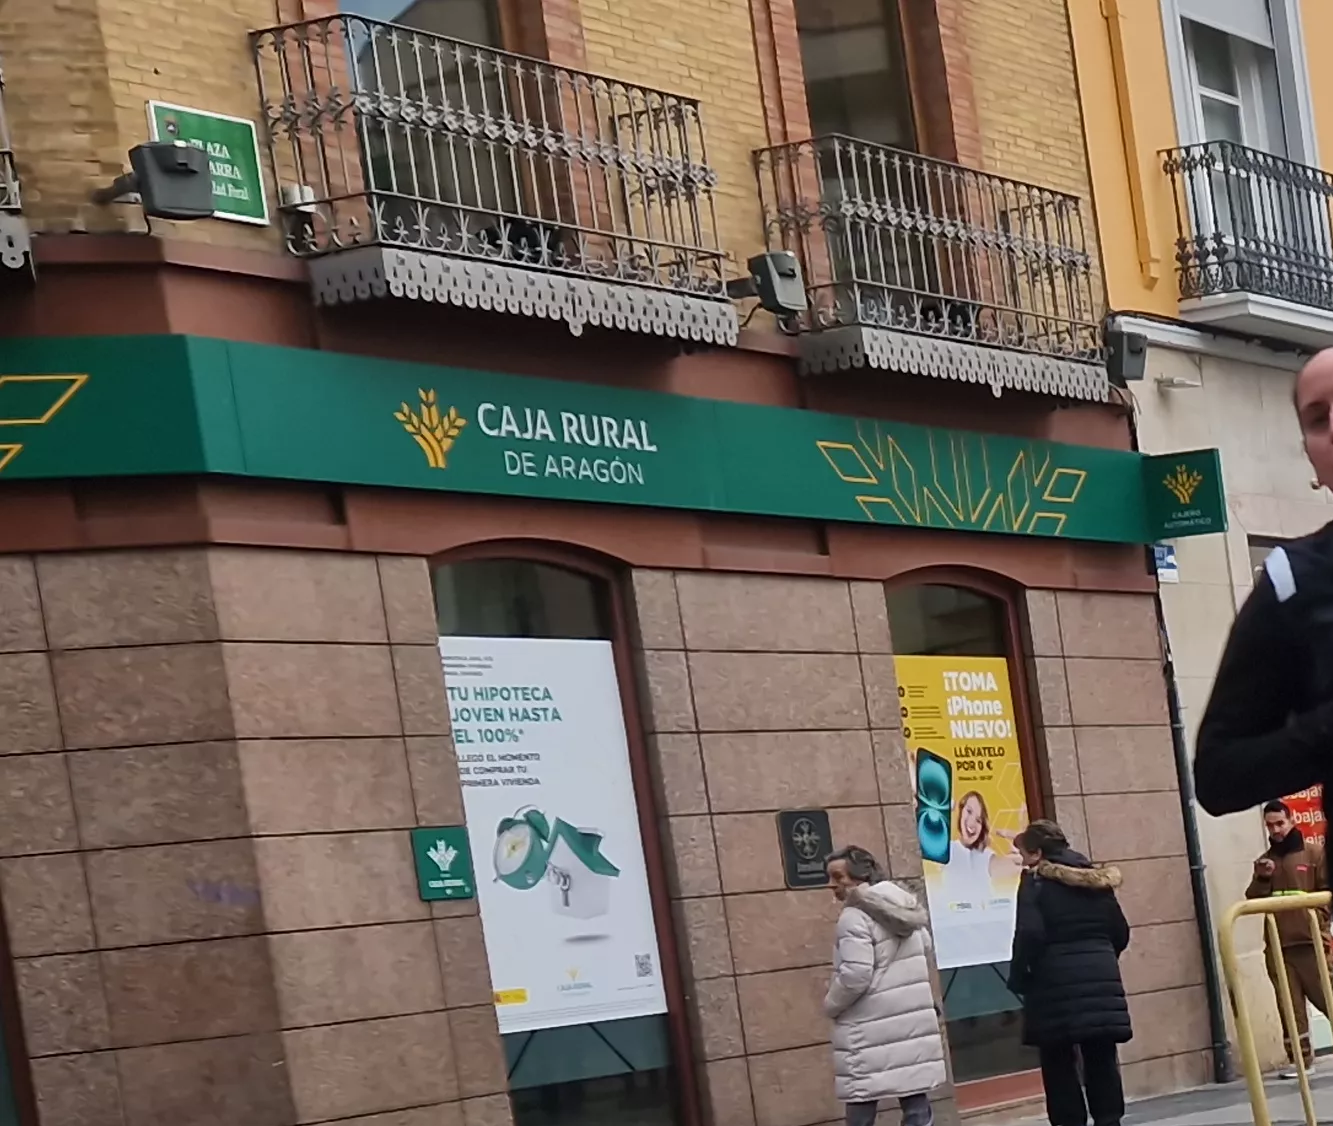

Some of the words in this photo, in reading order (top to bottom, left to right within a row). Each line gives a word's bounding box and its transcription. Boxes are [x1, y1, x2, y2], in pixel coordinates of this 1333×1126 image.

[477, 403, 557, 442] CAJA
[560, 411, 658, 452] RURAL
[504, 450, 539, 477] DE
[544, 455, 645, 485] ARAGÓN
[446, 686, 468, 701] TU
[472, 686, 554, 701] HIPOTECA
[452, 707, 505, 722] JOVEN
[508, 707, 562, 722] HASTA
[453, 728, 474, 744] EL
[950, 719, 1013, 739] NUEVO!
[498, 752, 541, 762] MOMENTO
[472, 765, 514, 775] COMPRAR
[516, 765, 527, 774] TU
[956, 760, 976, 772] POR
[979, 760, 985, 771] 0
[985, 760, 994, 771] €
